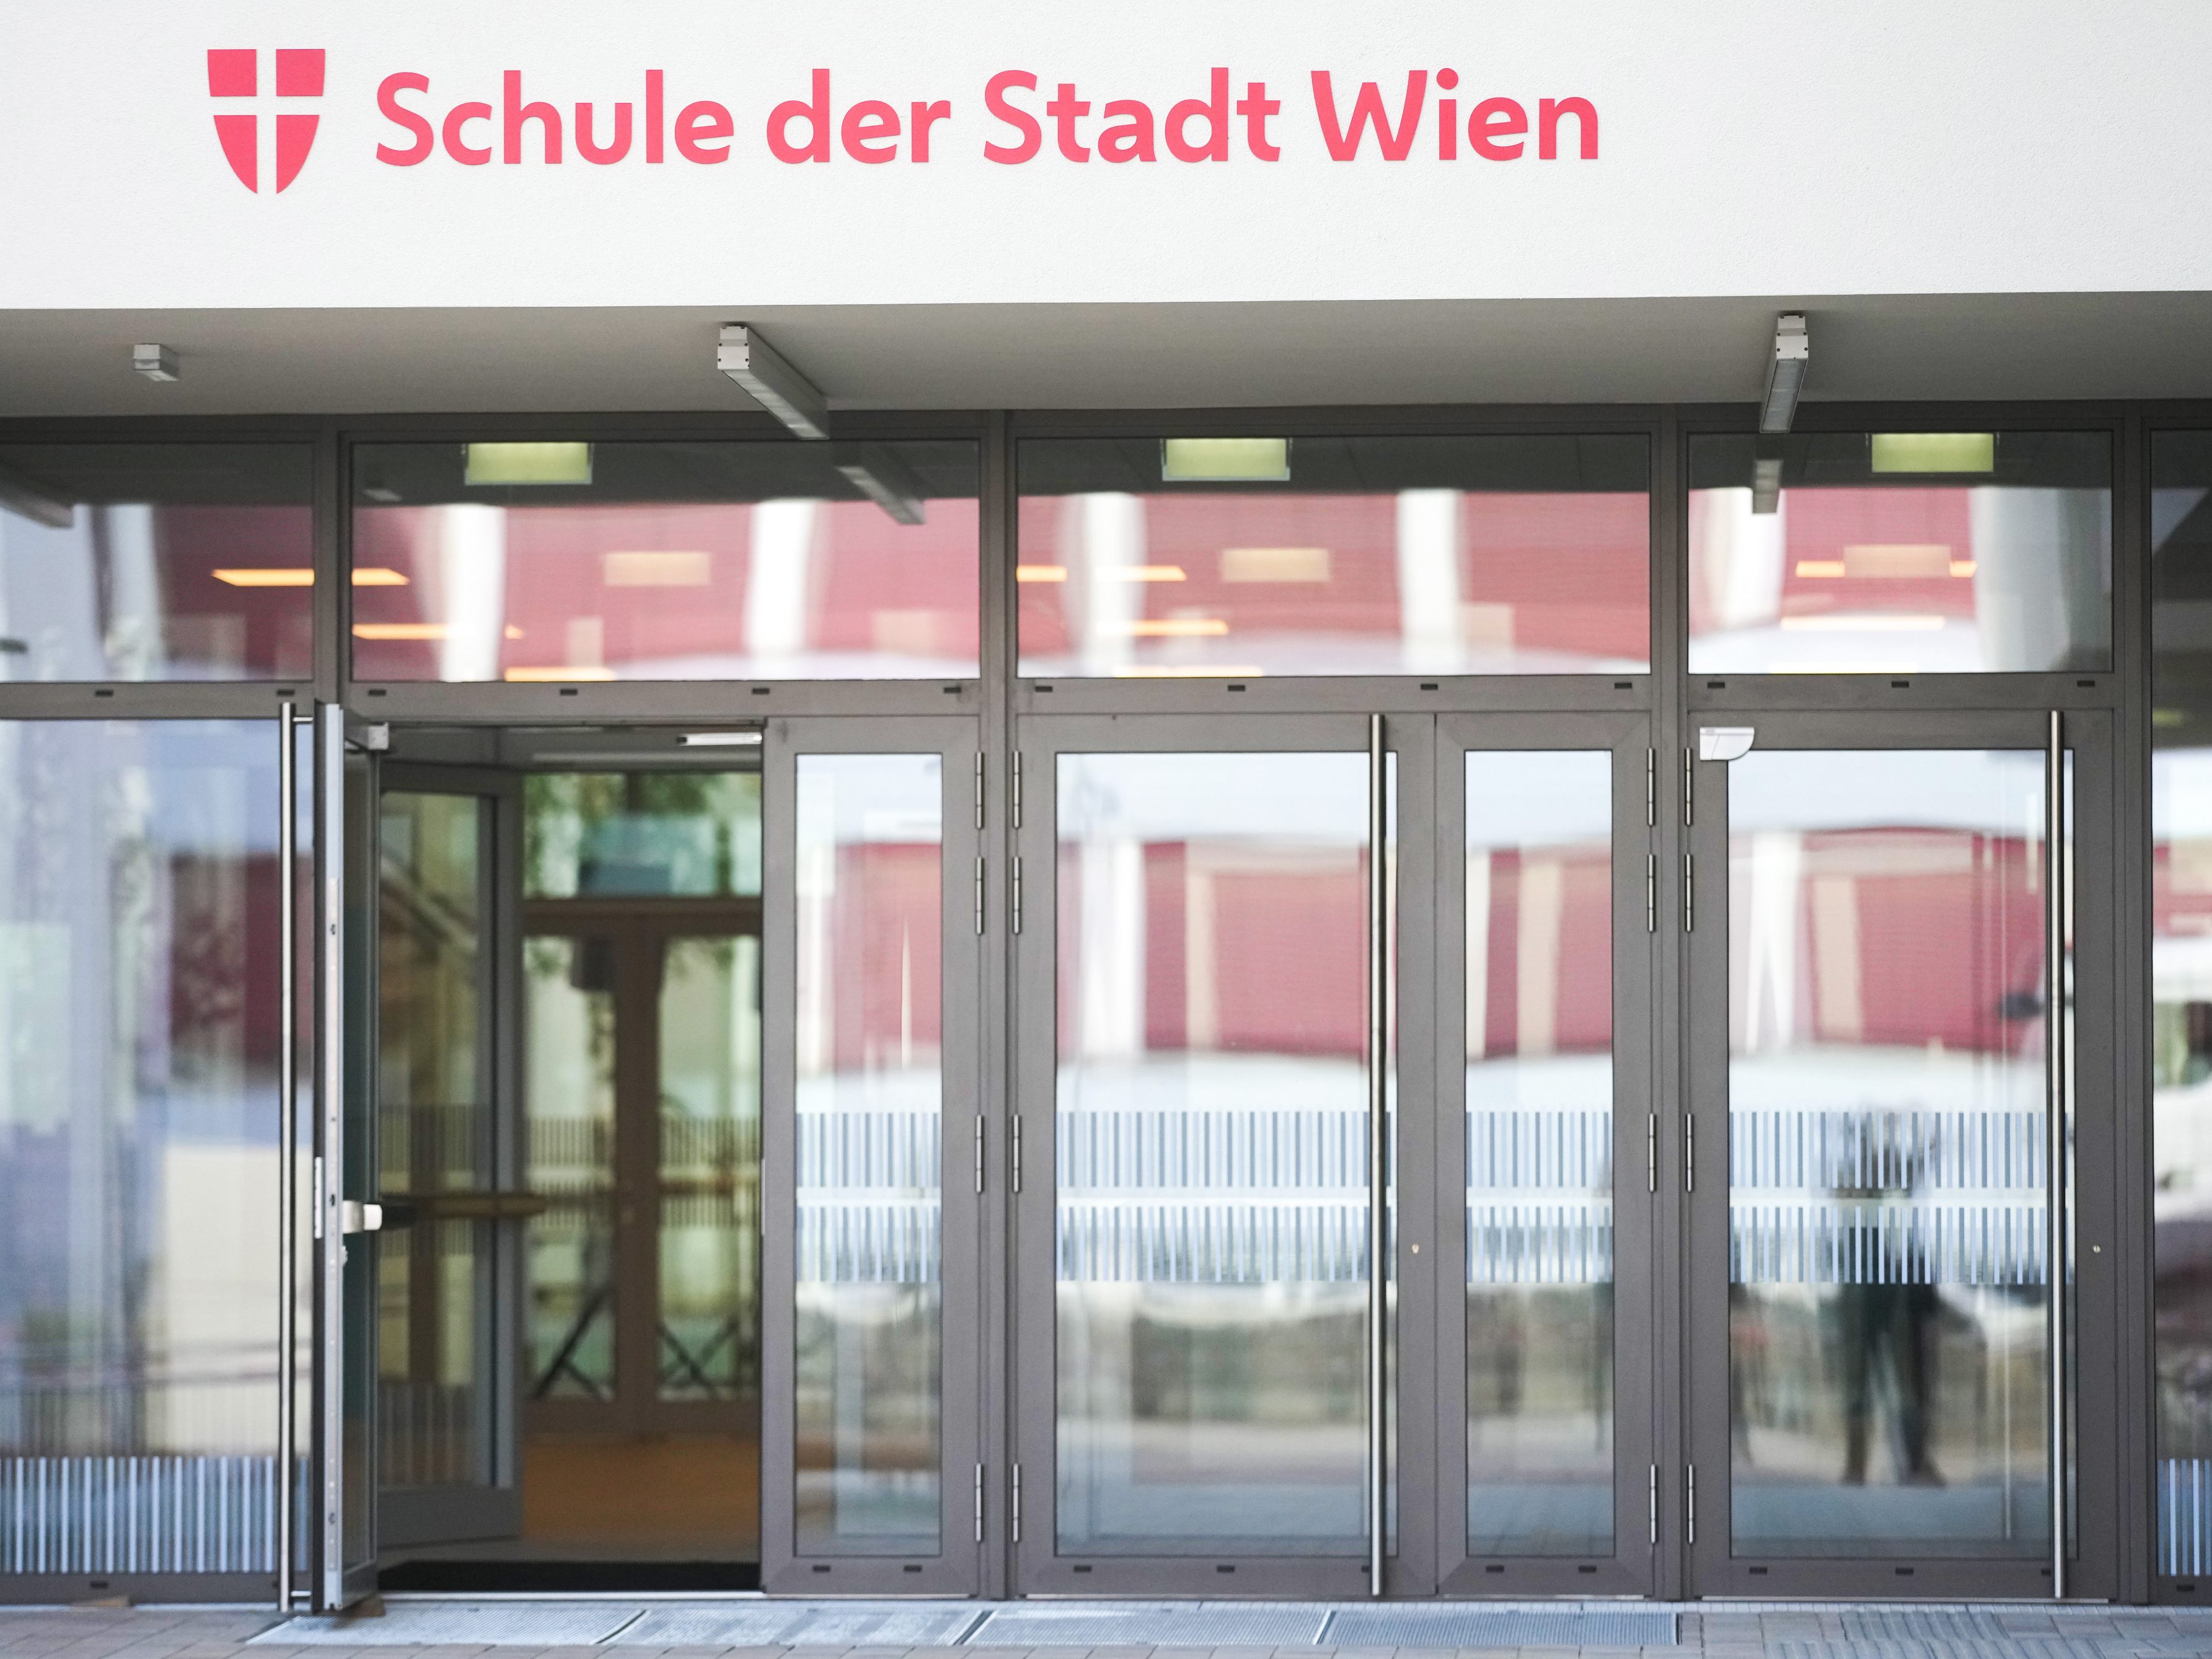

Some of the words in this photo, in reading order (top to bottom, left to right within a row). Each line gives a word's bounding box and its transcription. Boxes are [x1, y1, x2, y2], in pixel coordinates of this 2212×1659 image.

[376, 69, 734, 167] Schule
[767, 68, 951, 164] der
[984, 67, 1281, 164] Stadt
[1311, 68, 1598, 162] Wien
